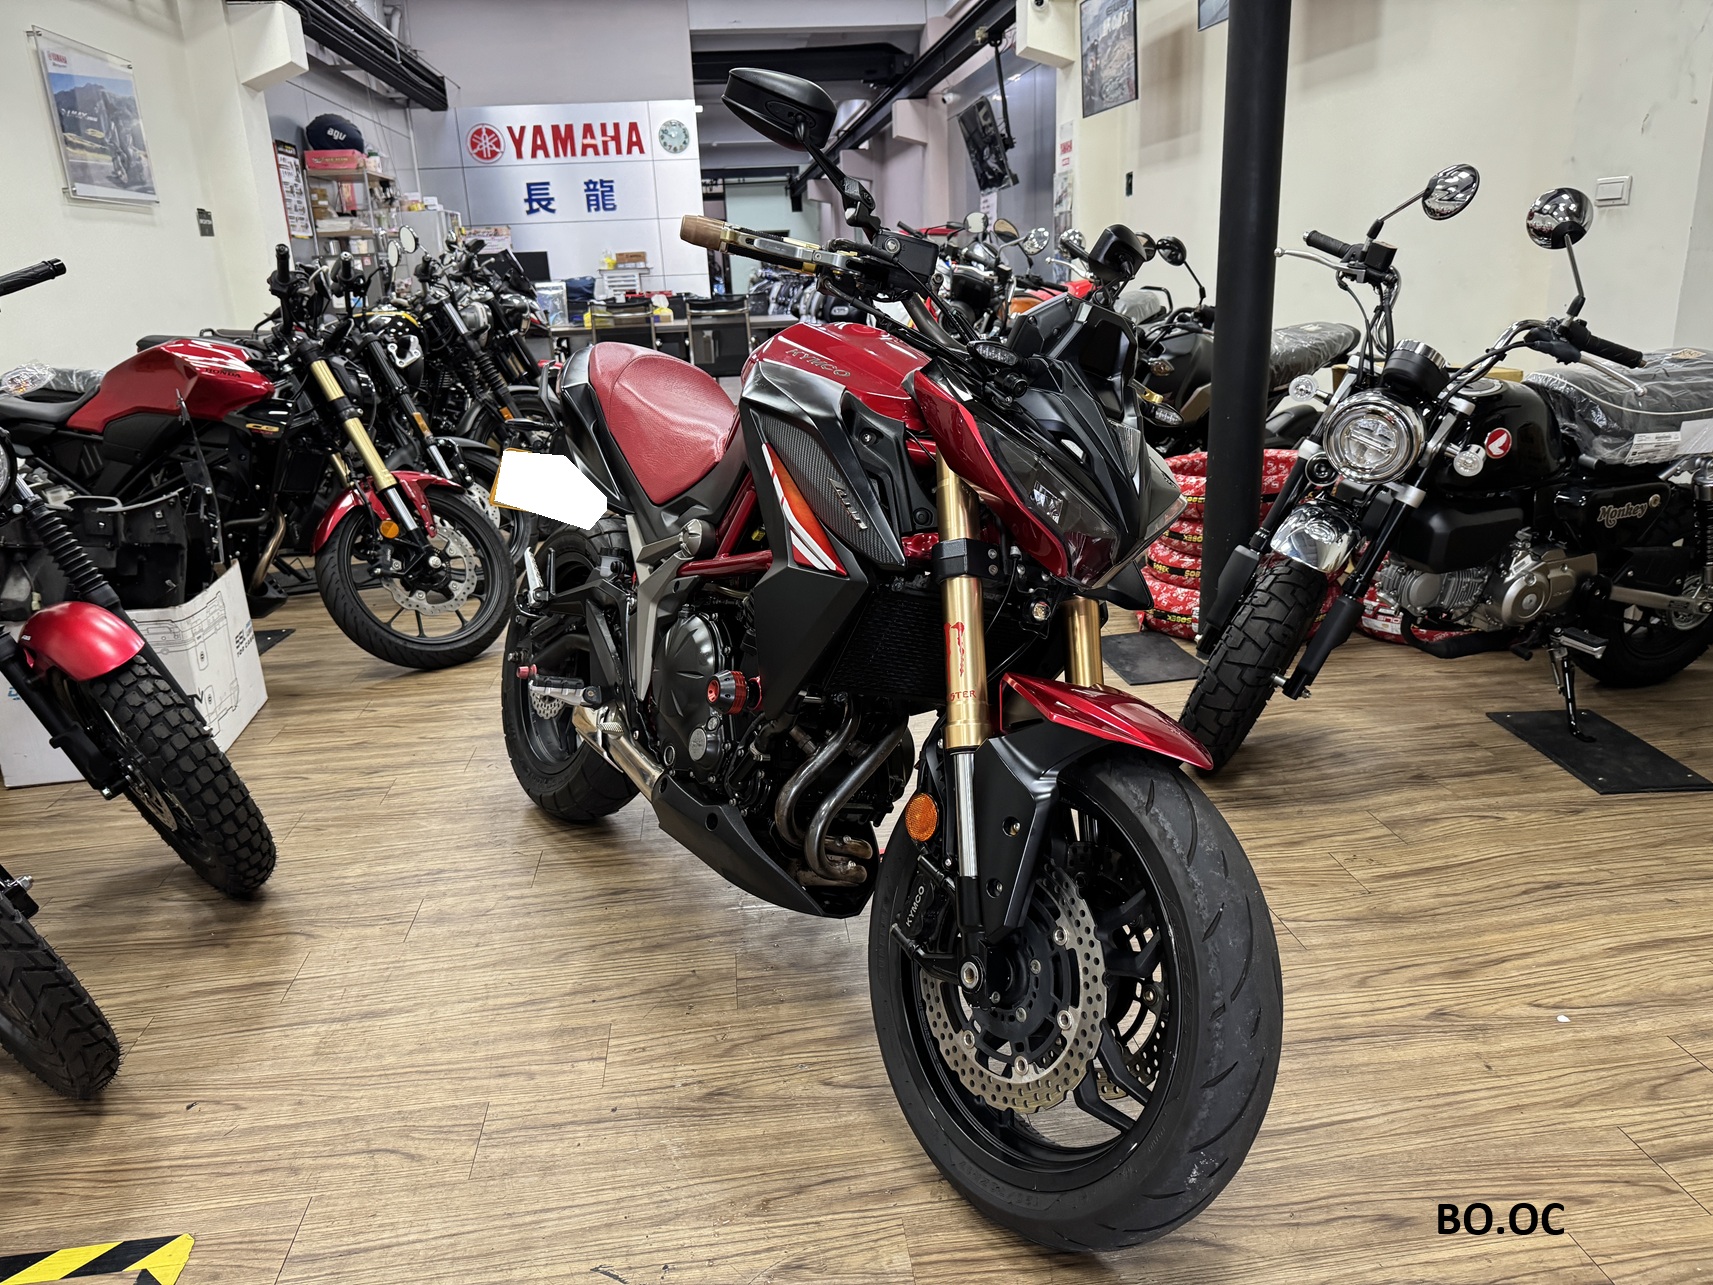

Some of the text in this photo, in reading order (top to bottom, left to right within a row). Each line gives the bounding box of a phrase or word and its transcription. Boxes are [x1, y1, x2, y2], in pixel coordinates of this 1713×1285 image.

[326, 127, 347, 141] agv
[506, 121, 646, 160] YAMAHA
[204, 367, 242, 379] HONDA
[785, 348, 851, 377] KYMCO
[1596, 501, 1649, 529] Monkey
[948, 690, 977, 702] STER
[905, 885, 925, 928] KYMCO
